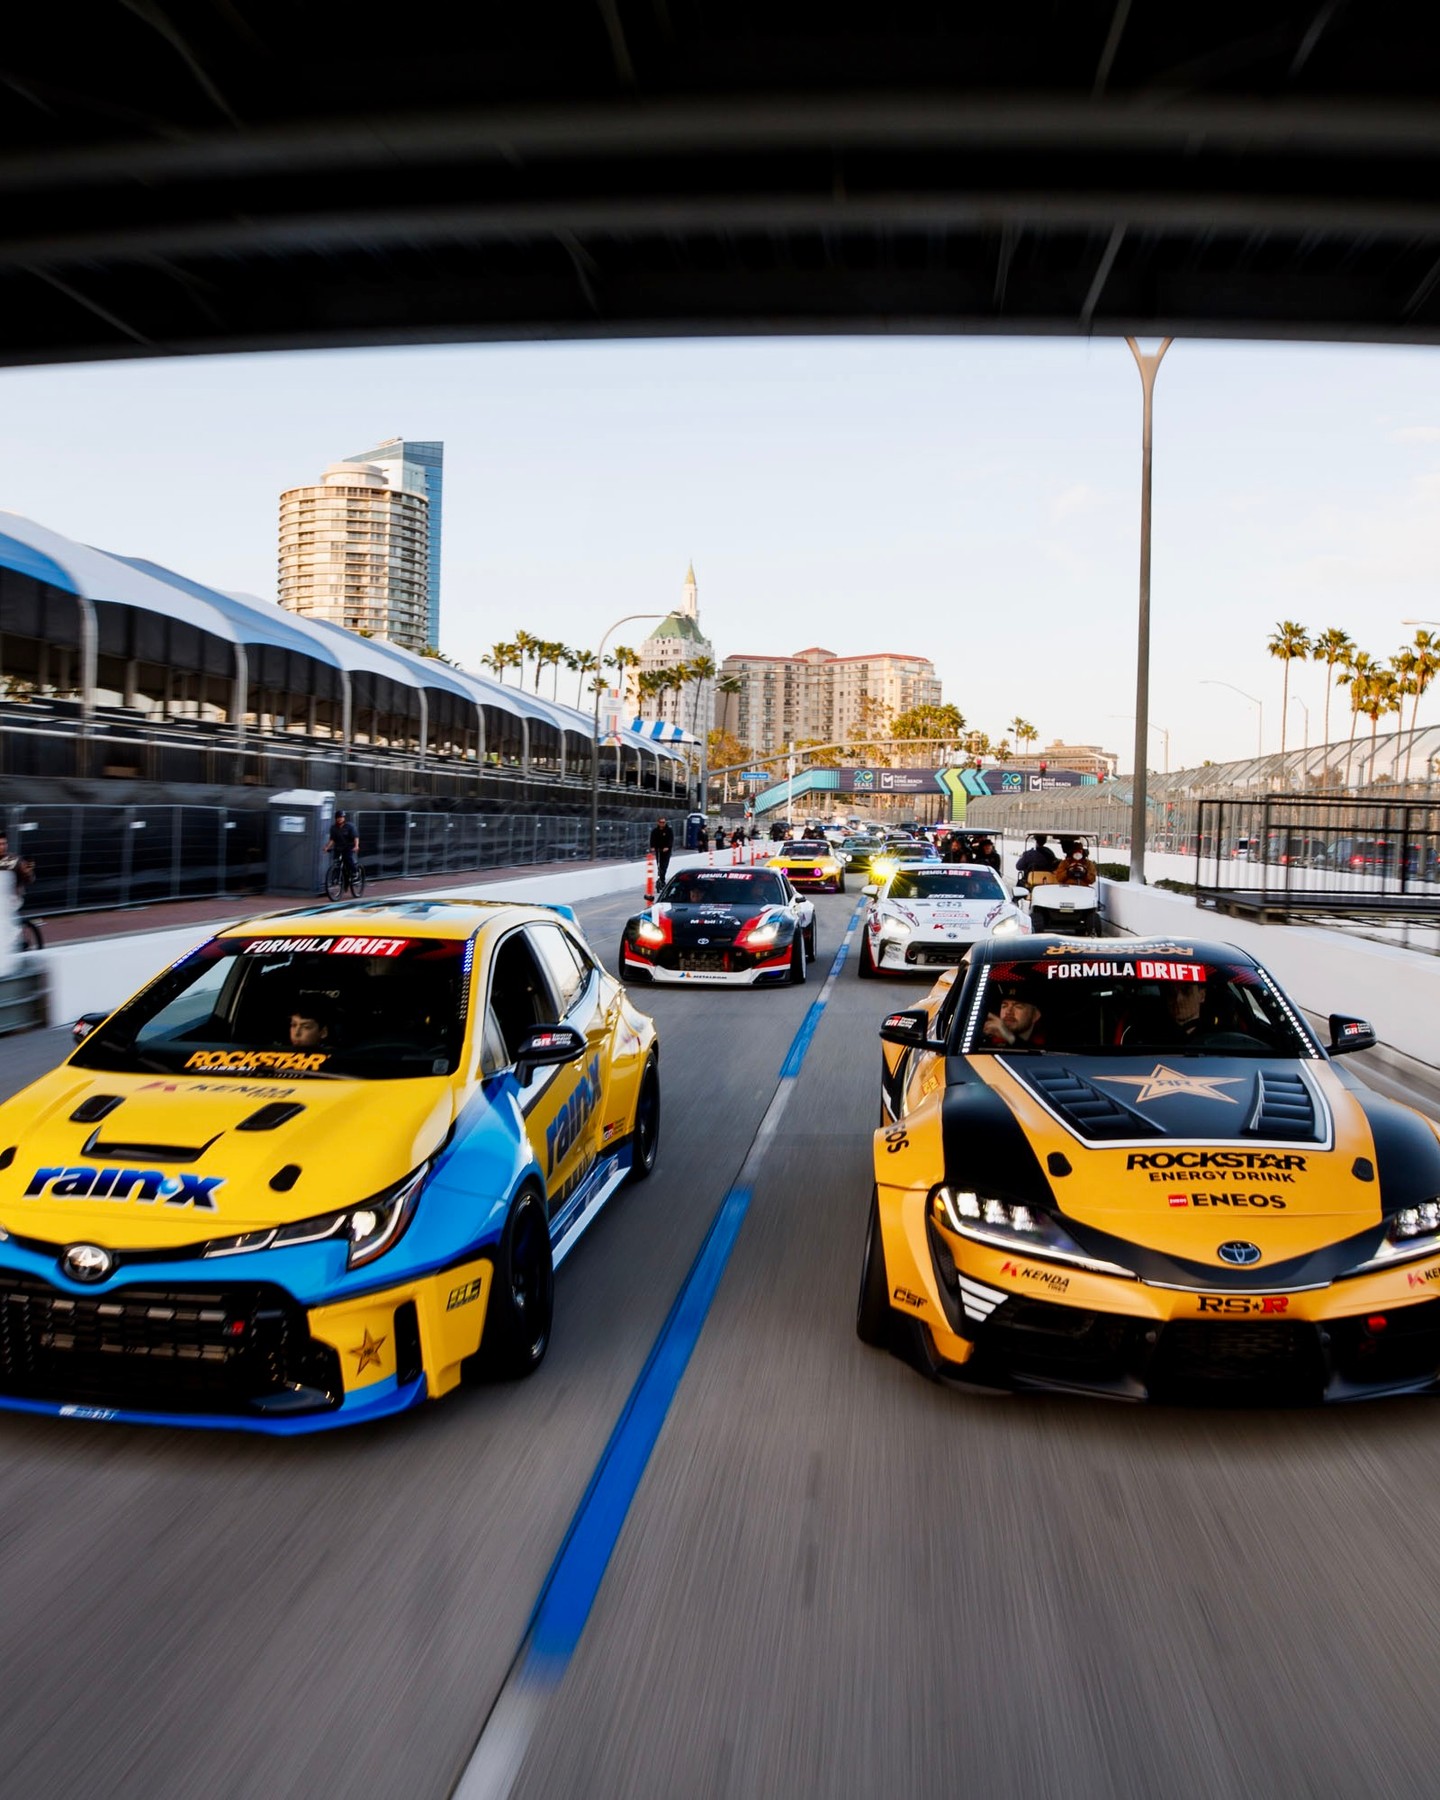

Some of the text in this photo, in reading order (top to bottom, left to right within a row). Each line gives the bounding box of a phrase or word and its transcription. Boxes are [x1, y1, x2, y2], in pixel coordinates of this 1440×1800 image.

[853, 770, 874, 783] 20
[1001, 773, 1022, 785] 20
[728, 872, 752, 880] DRIFT
[243, 937, 406, 955] FORMULA DRIFT
[1047, 962, 1201, 982] FORMULA DRIFT
[1344, 1027, 1359, 1035] GR
[531, 1037, 551, 1047] GR
[184, 1051, 327, 1072] ROCKSTAR
[1126, 1152, 1308, 1172] ROCKSTAR
[1149, 1171, 1296, 1183] ENERGY DRINK
[1191, 1193, 1287, 1209] ENEOS
[1021, 1267, 1070, 1288] KENDA
[1425, 1267, 1440, 1281] KE
[893, 1288, 928, 1309] CSF
